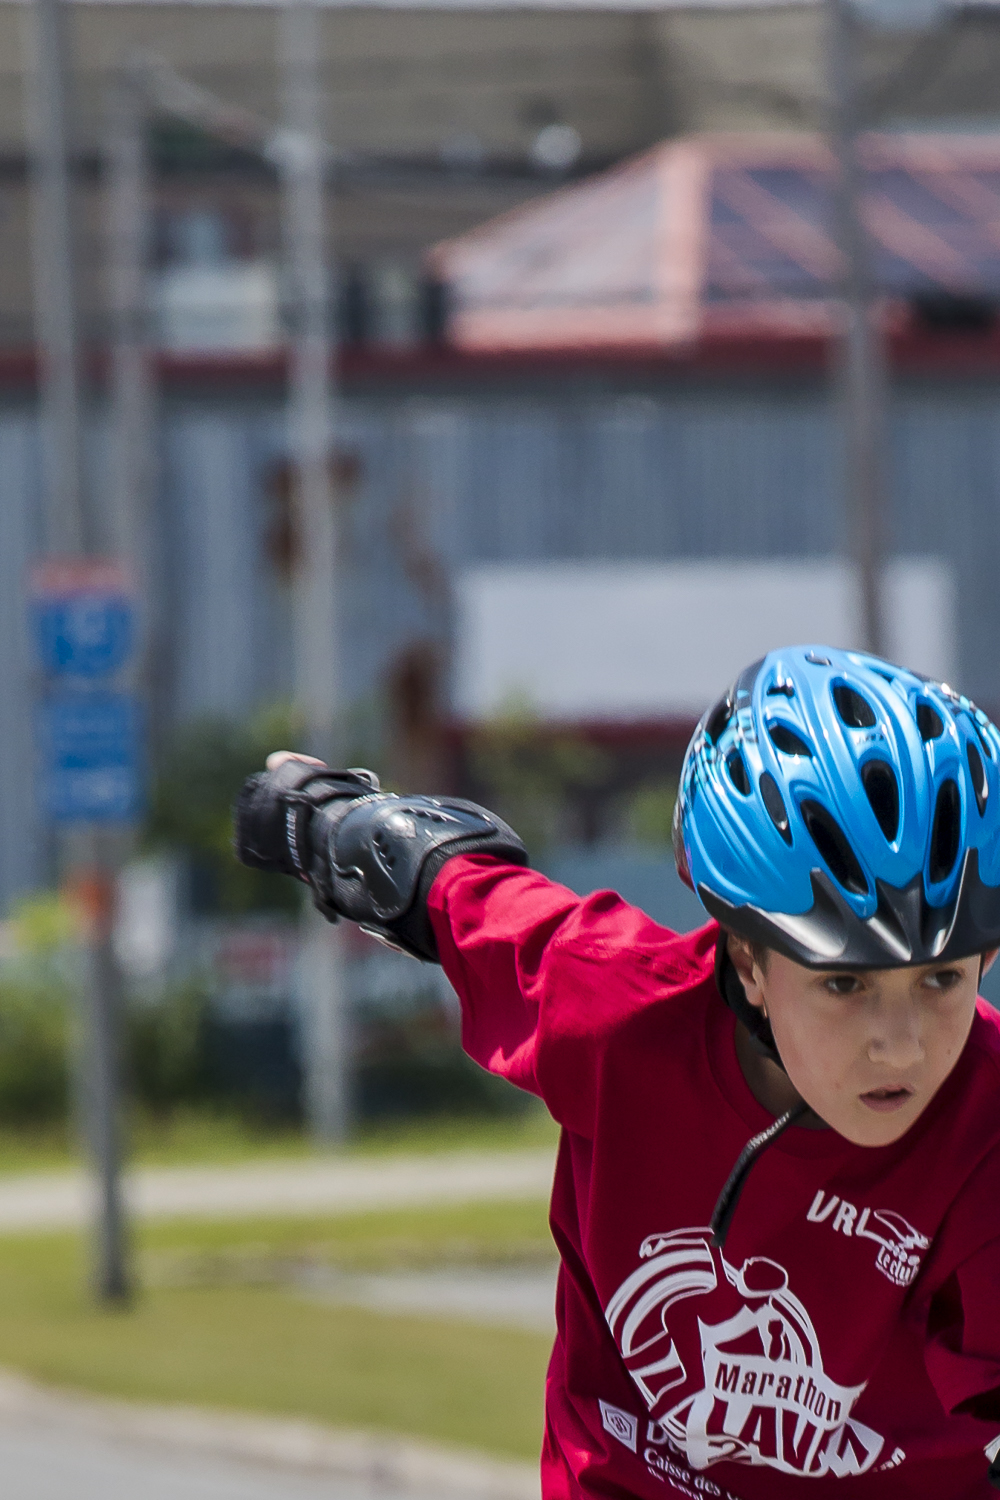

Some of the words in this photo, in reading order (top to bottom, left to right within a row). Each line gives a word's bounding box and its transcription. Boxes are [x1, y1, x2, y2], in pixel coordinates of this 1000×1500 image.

[807, 1189, 892, 1251] VRL
[714, 1361, 841, 1421] Marathon
[643, 1447, 691, 1483] Caisse
[694, 1475, 721, 1497] des
